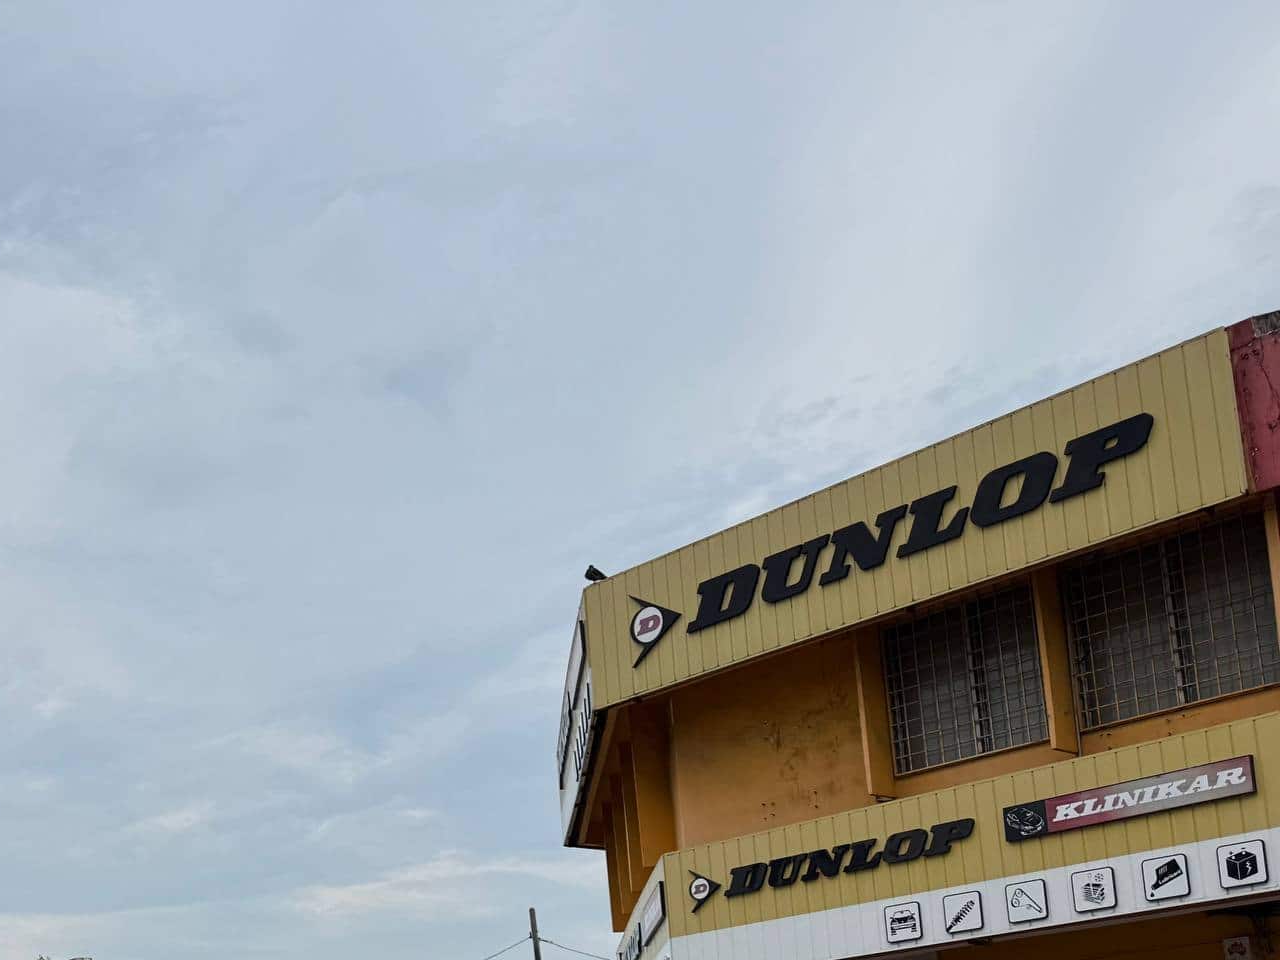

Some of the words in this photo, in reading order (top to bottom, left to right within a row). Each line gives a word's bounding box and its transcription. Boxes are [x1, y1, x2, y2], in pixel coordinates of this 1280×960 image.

[636, 612, 661, 637] D
[686, 412, 1154, 634] DUNLOP
[1052, 766, 1247, 823] KLINIKAR
[724, 817, 975, 898] DUNLOP
